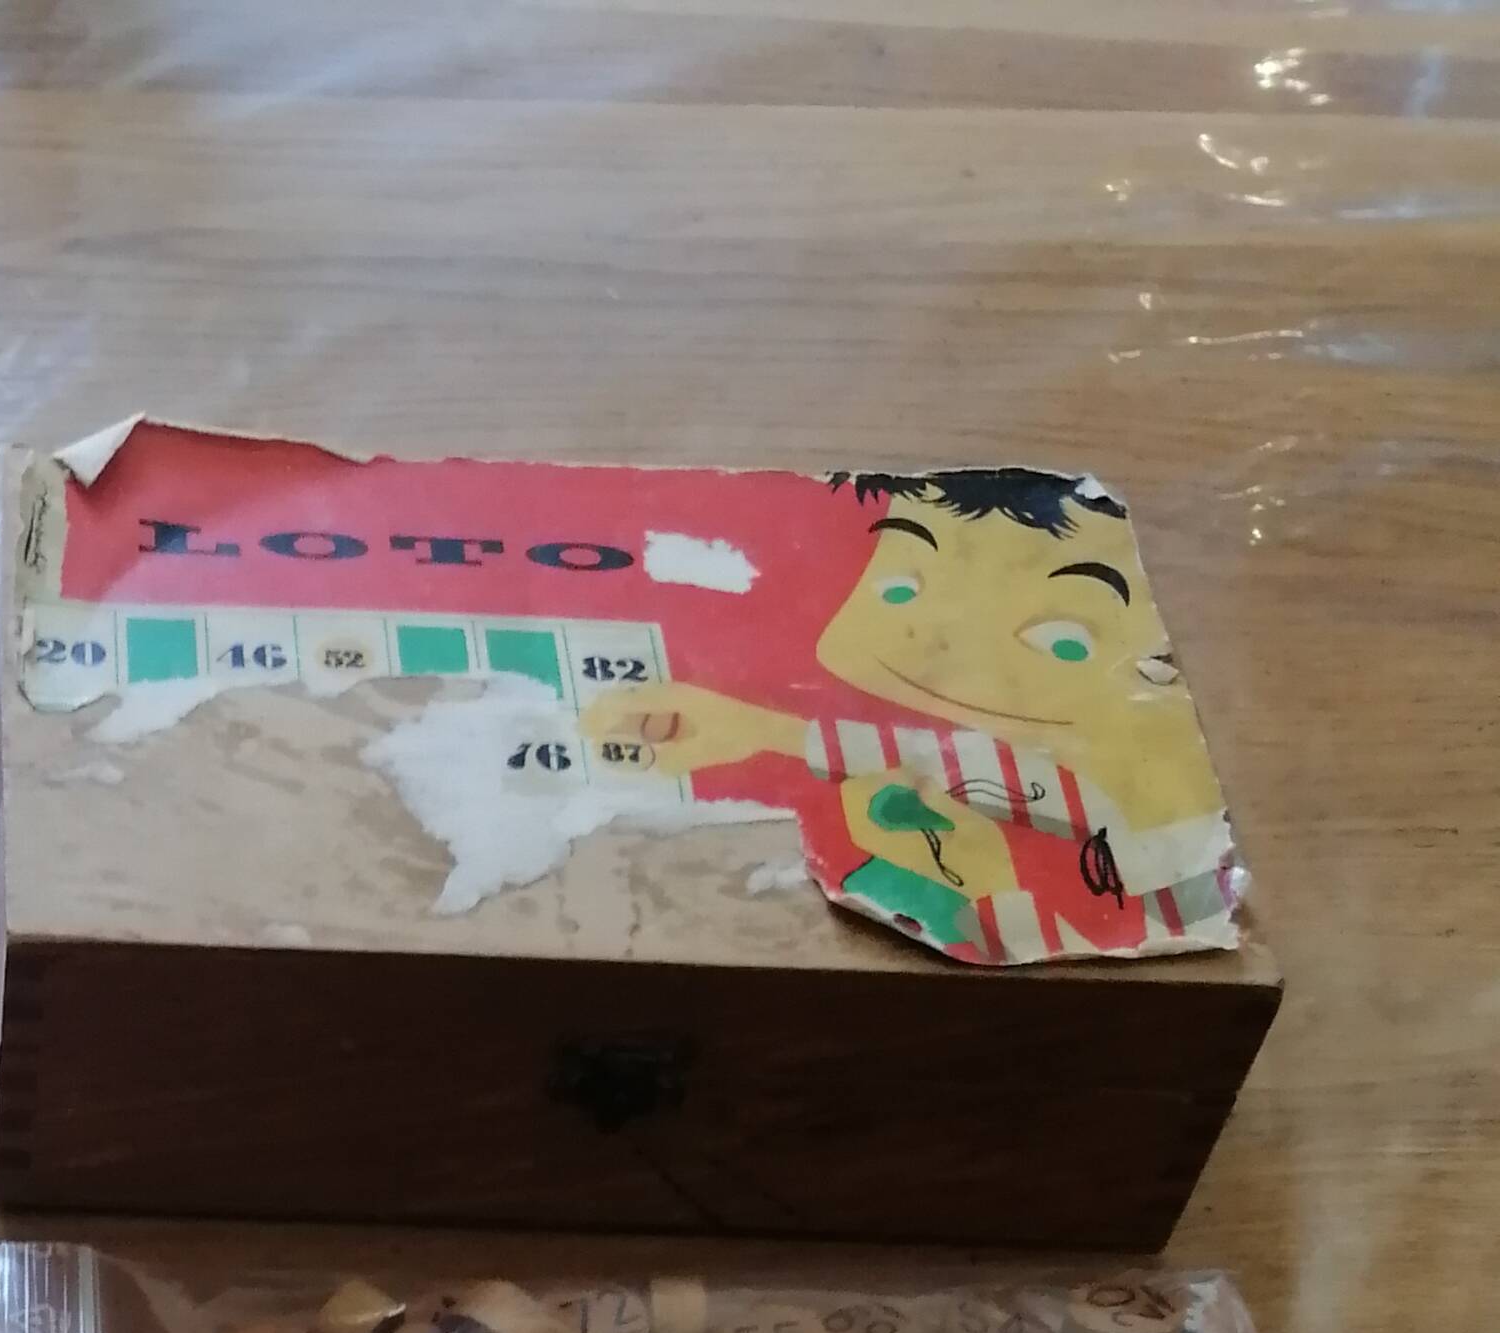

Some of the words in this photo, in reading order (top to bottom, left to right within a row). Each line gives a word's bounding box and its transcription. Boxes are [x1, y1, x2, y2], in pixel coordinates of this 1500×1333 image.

[139, 519, 635, 573] LOTO
[36, 639, 106, 666] 20
[323, 648, 365, 670] 52
[583, 655, 648, 684] 82
[601, 742, 644, 765] 87
